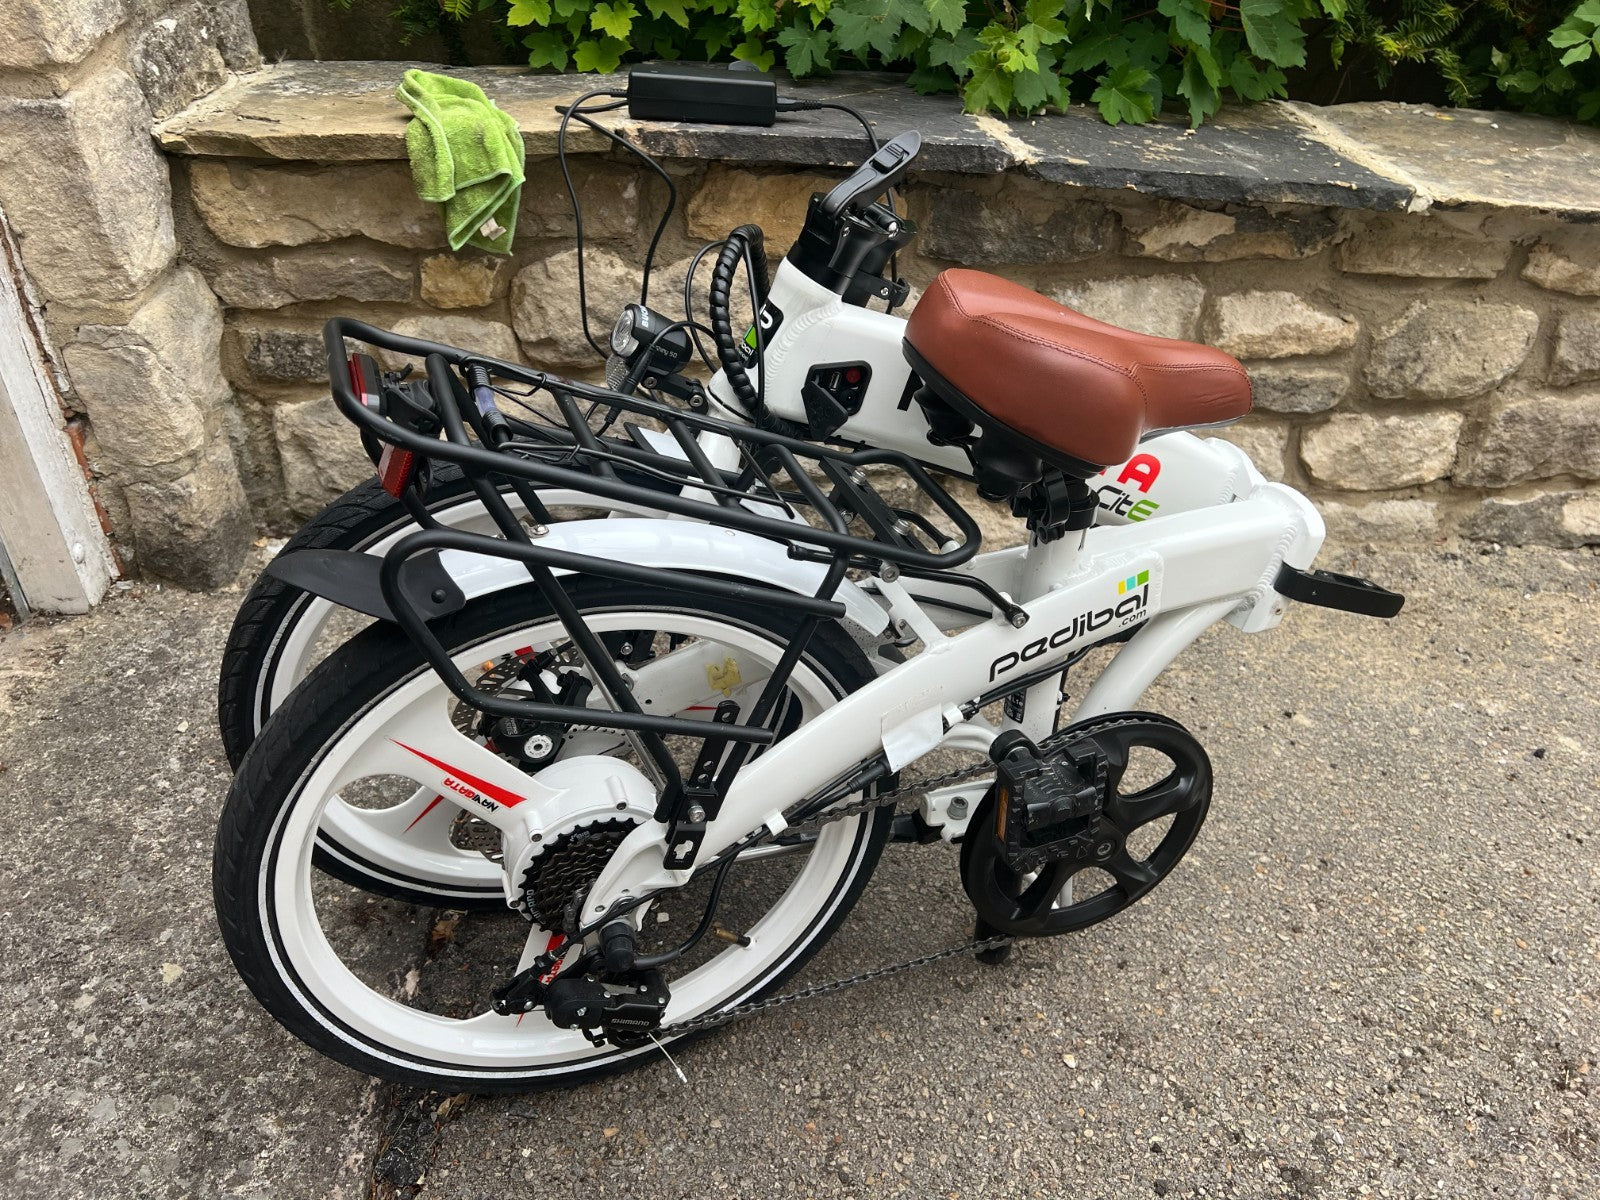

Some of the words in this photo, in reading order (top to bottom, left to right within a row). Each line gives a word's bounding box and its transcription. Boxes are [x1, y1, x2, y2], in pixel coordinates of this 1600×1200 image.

[989, 583, 1149, 683] pedibal
[443, 776, 500, 813] NAVIGATA
[611, 1017, 650, 1026] SHIMANO
